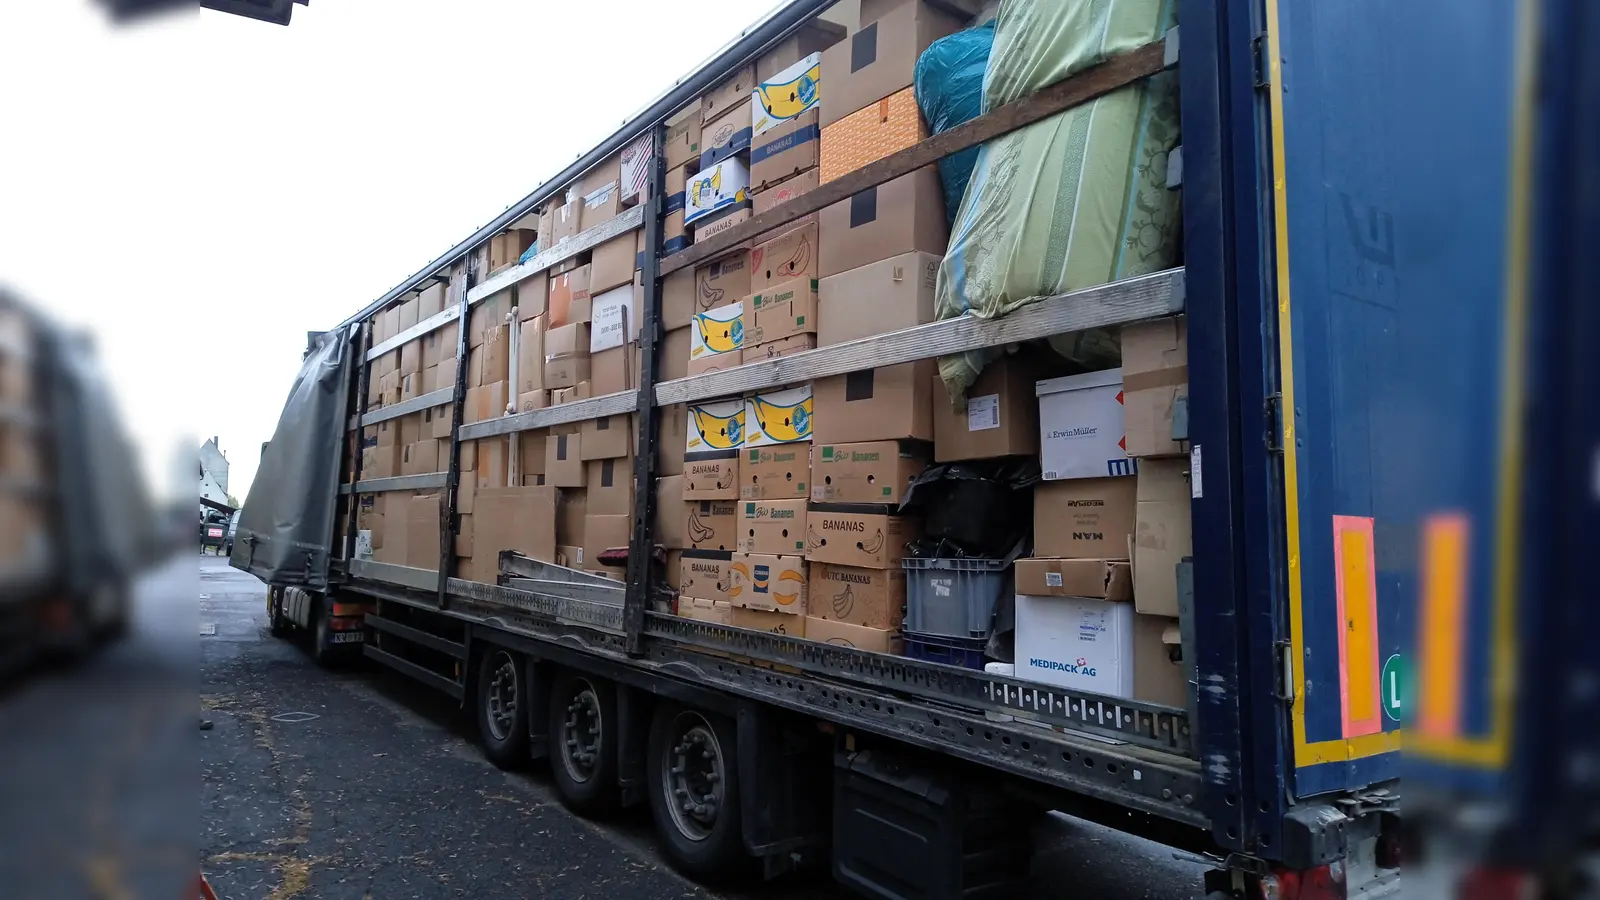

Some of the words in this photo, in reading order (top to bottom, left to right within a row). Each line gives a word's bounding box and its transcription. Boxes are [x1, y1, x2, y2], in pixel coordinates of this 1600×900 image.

[766, 137, 793, 154] BANANAS
[704, 219, 732, 238] BANANAS
[1053, 429, 1073, 438] Erwin
[1073, 427, 1097, 436] Müller
[759, 452, 772, 464] Bio
[834, 450, 849, 463] Bio
[851, 451, 880, 462] Bananen
[692, 463, 720, 475] BANANAS
[712, 505, 735, 516] Bananen
[755, 506, 769, 519] Bio
[770, 507, 795, 519] Bananen
[822, 519, 865, 532] BANANAS
[1072, 532, 1103, 540] MAN
[691, 562, 720, 574] BANANAS
[827, 571, 840, 581] UTC
[840, 573, 871, 584] BANANAS
[1030, 657, 1078, 675] MEDIPACK
[1081, 666, 1096, 677] AG
